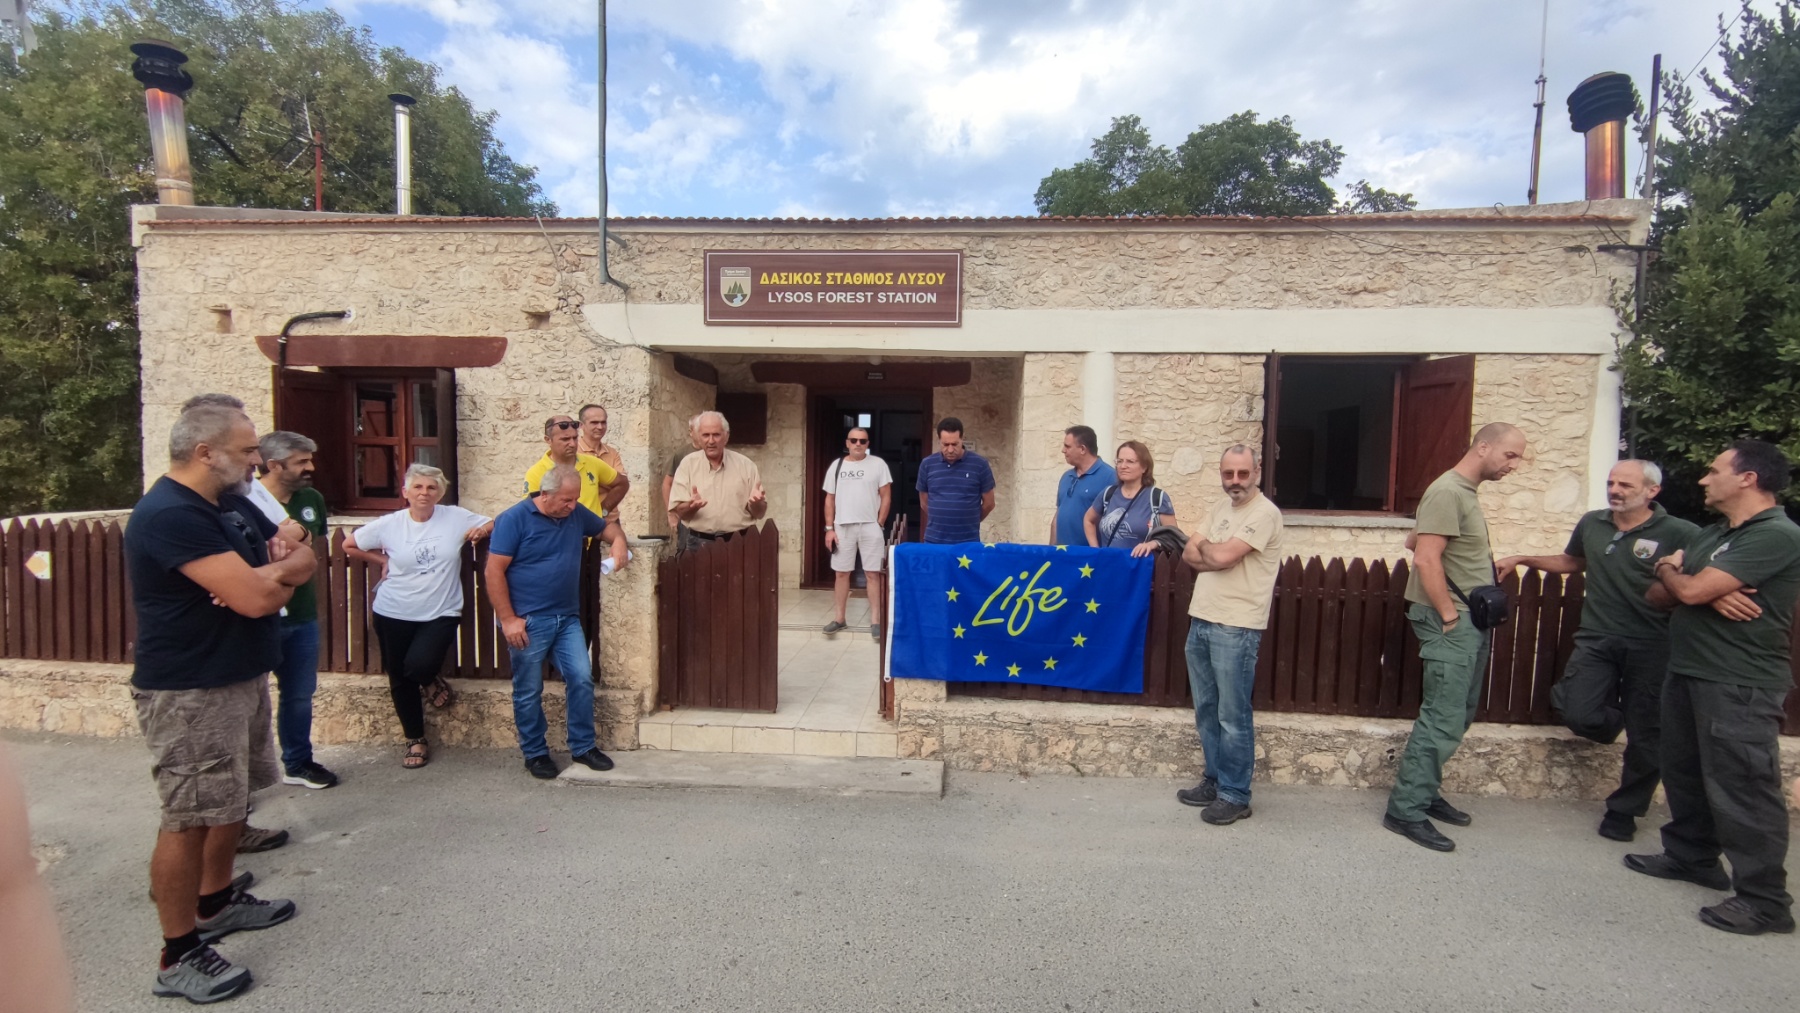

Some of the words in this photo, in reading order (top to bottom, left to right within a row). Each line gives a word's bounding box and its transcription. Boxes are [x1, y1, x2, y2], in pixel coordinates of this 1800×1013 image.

[759, 272, 822, 285] ΔΑΣΙΚΟΣ
[826, 272, 894, 285] ΣΤΑΘΜΟΣ
[897, 272, 947, 285] ΛΥΣΟΥ
[768, 292, 813, 303] LYSOS
[817, 291, 873, 303] FOREST
[877, 291, 937, 304] STATION
[971, 561, 1068, 637] Life
